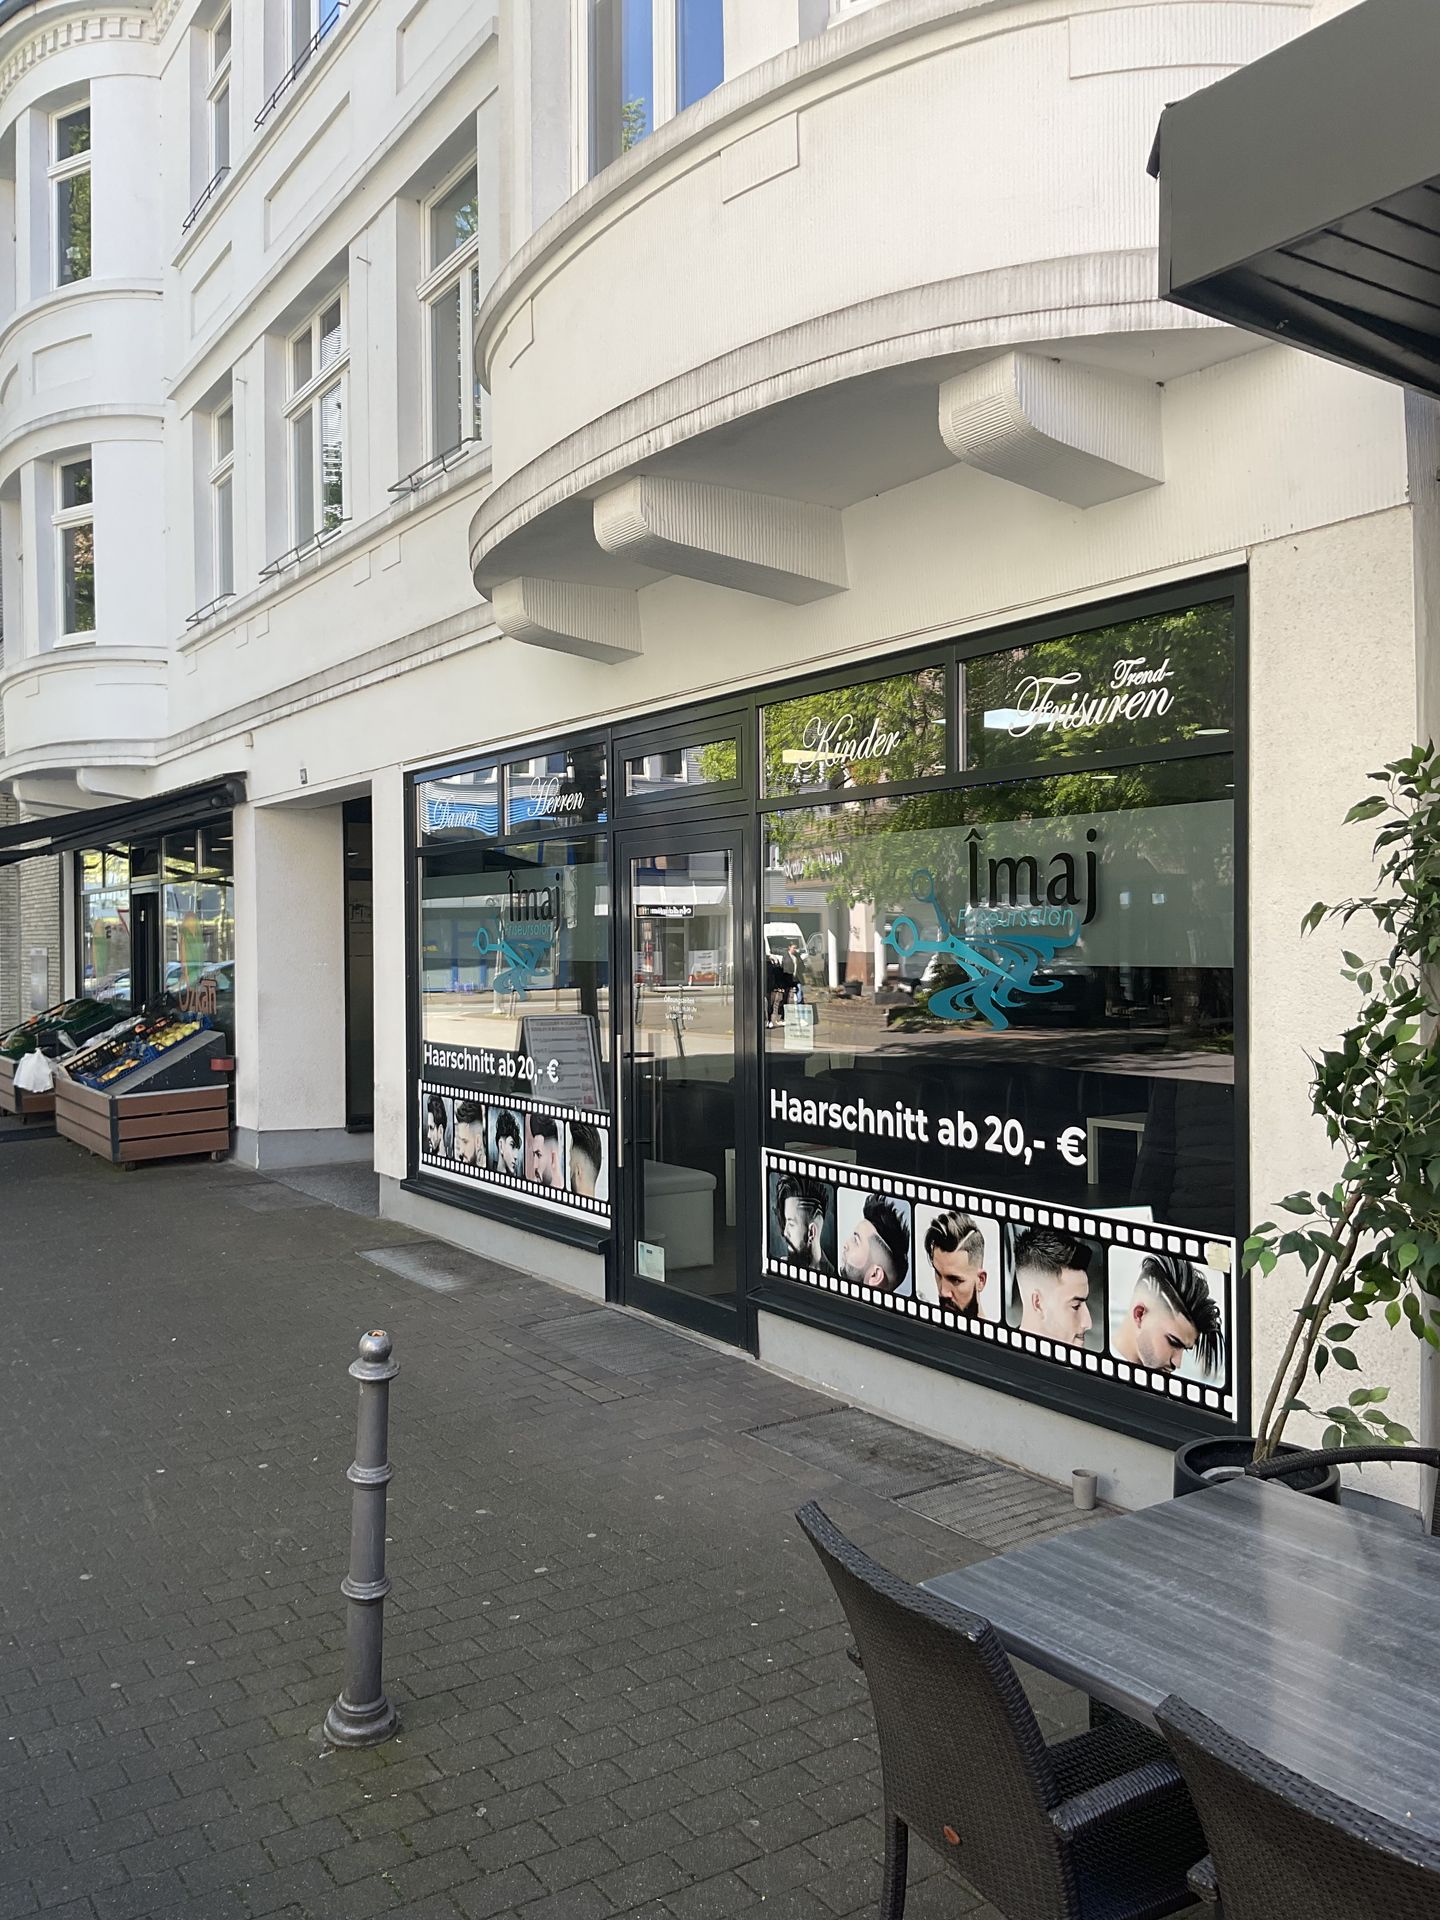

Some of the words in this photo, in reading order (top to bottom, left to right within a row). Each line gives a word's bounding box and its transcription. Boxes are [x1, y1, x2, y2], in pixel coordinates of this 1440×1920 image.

[1110, 657, 1174, 689] Trend-
[1008, 672, 1175, 738] Frisuren
[798, 713, 901, 771] Kinder
[433, 795, 480, 831] Damen
[527, 776, 584, 817] Herren
[424, 1043, 496, 1075] Haarschnitt
[498, 1052, 516, 1078] ab
[517, 1055, 543, 1086] 20,-
[547, 1058, 560, 1084] €
[770, 1088, 929, 1142] Haarschnitt
[937, 1110, 979, 1150] ab
[984, 1115, 1046, 1165] 20,-
[1057, 1126, 1088, 1166] €
